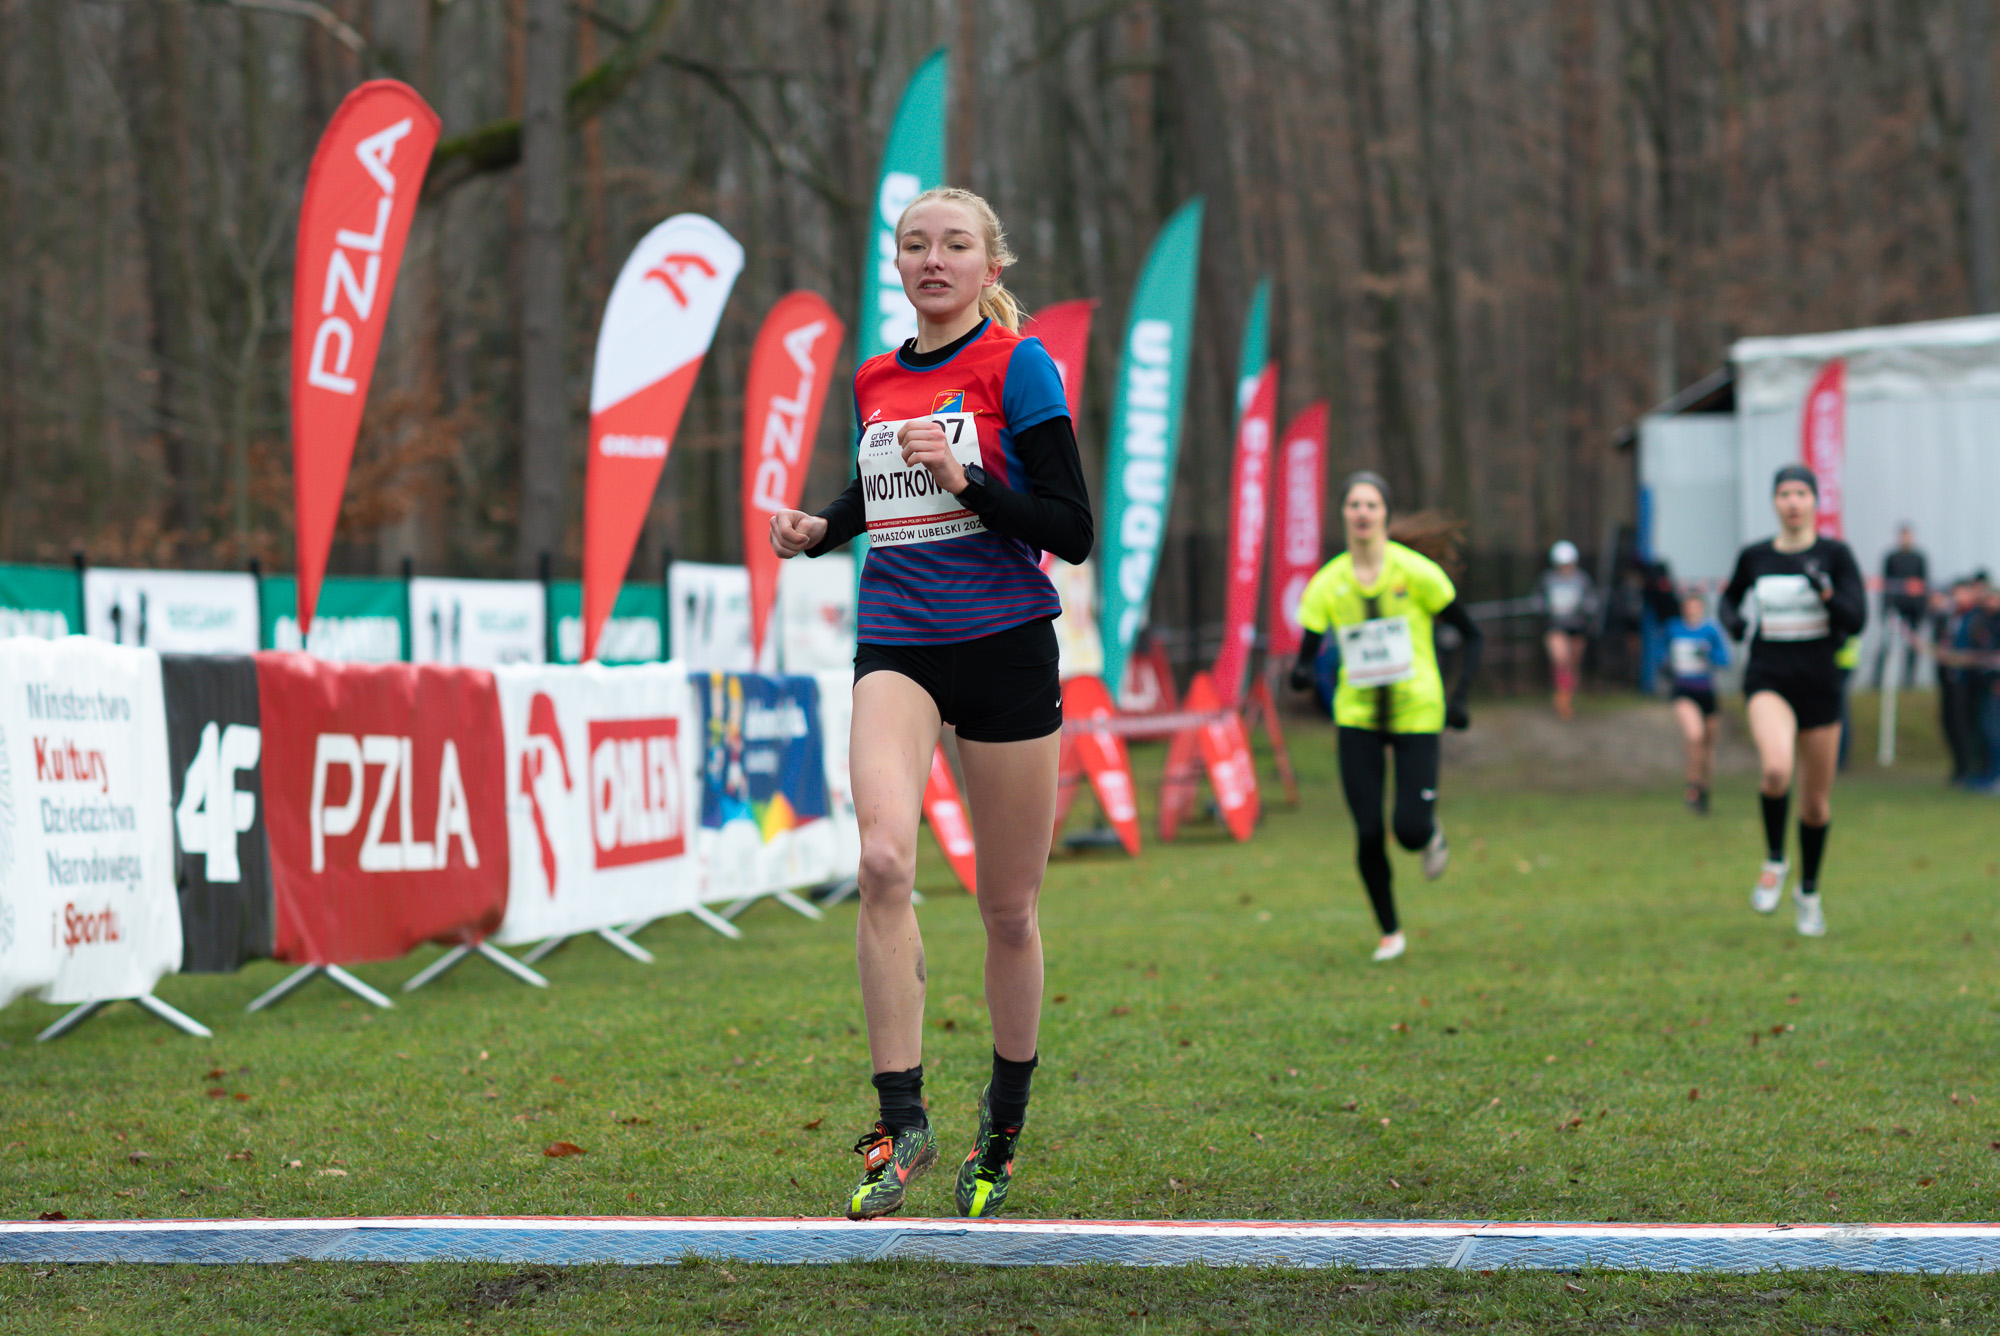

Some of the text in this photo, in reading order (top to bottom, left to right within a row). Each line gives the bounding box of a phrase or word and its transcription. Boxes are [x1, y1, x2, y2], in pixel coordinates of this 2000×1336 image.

[308, 117, 414, 395] PZLA
[752, 319, 828, 513] PZLA
[918, 523, 961, 538] LUBELSKI
[964, 519, 983, 532] 202
[176, 721, 261, 882] 4F
[310, 733, 480, 874] PZLA
